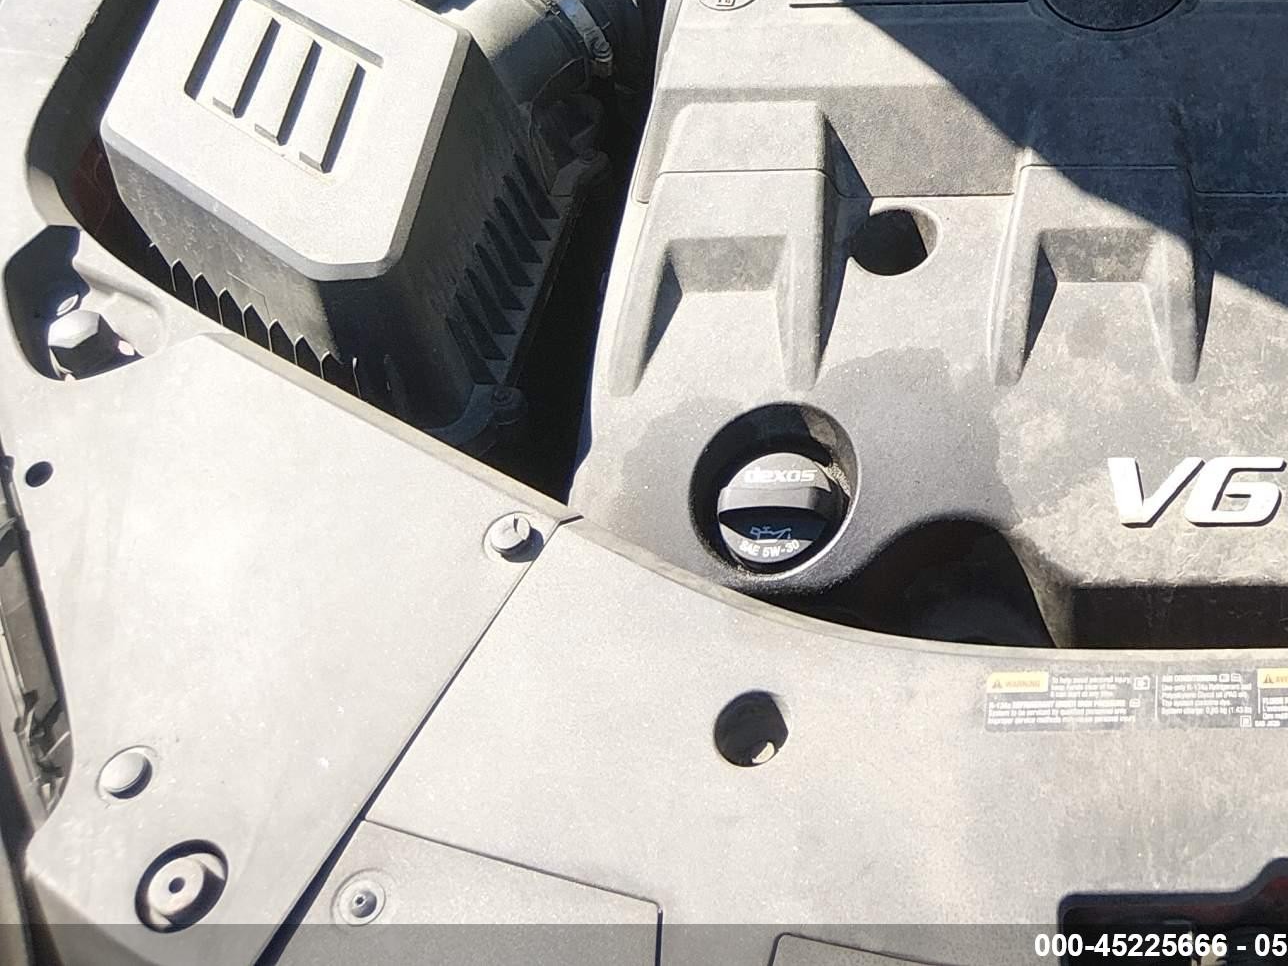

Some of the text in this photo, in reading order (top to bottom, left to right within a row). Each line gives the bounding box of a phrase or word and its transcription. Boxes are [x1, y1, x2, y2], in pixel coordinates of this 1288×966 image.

[743, 467, 818, 483] dexos
[1107, 456, 1287, 528] V6
[739, 539, 800, 558] SAE 5W-30
